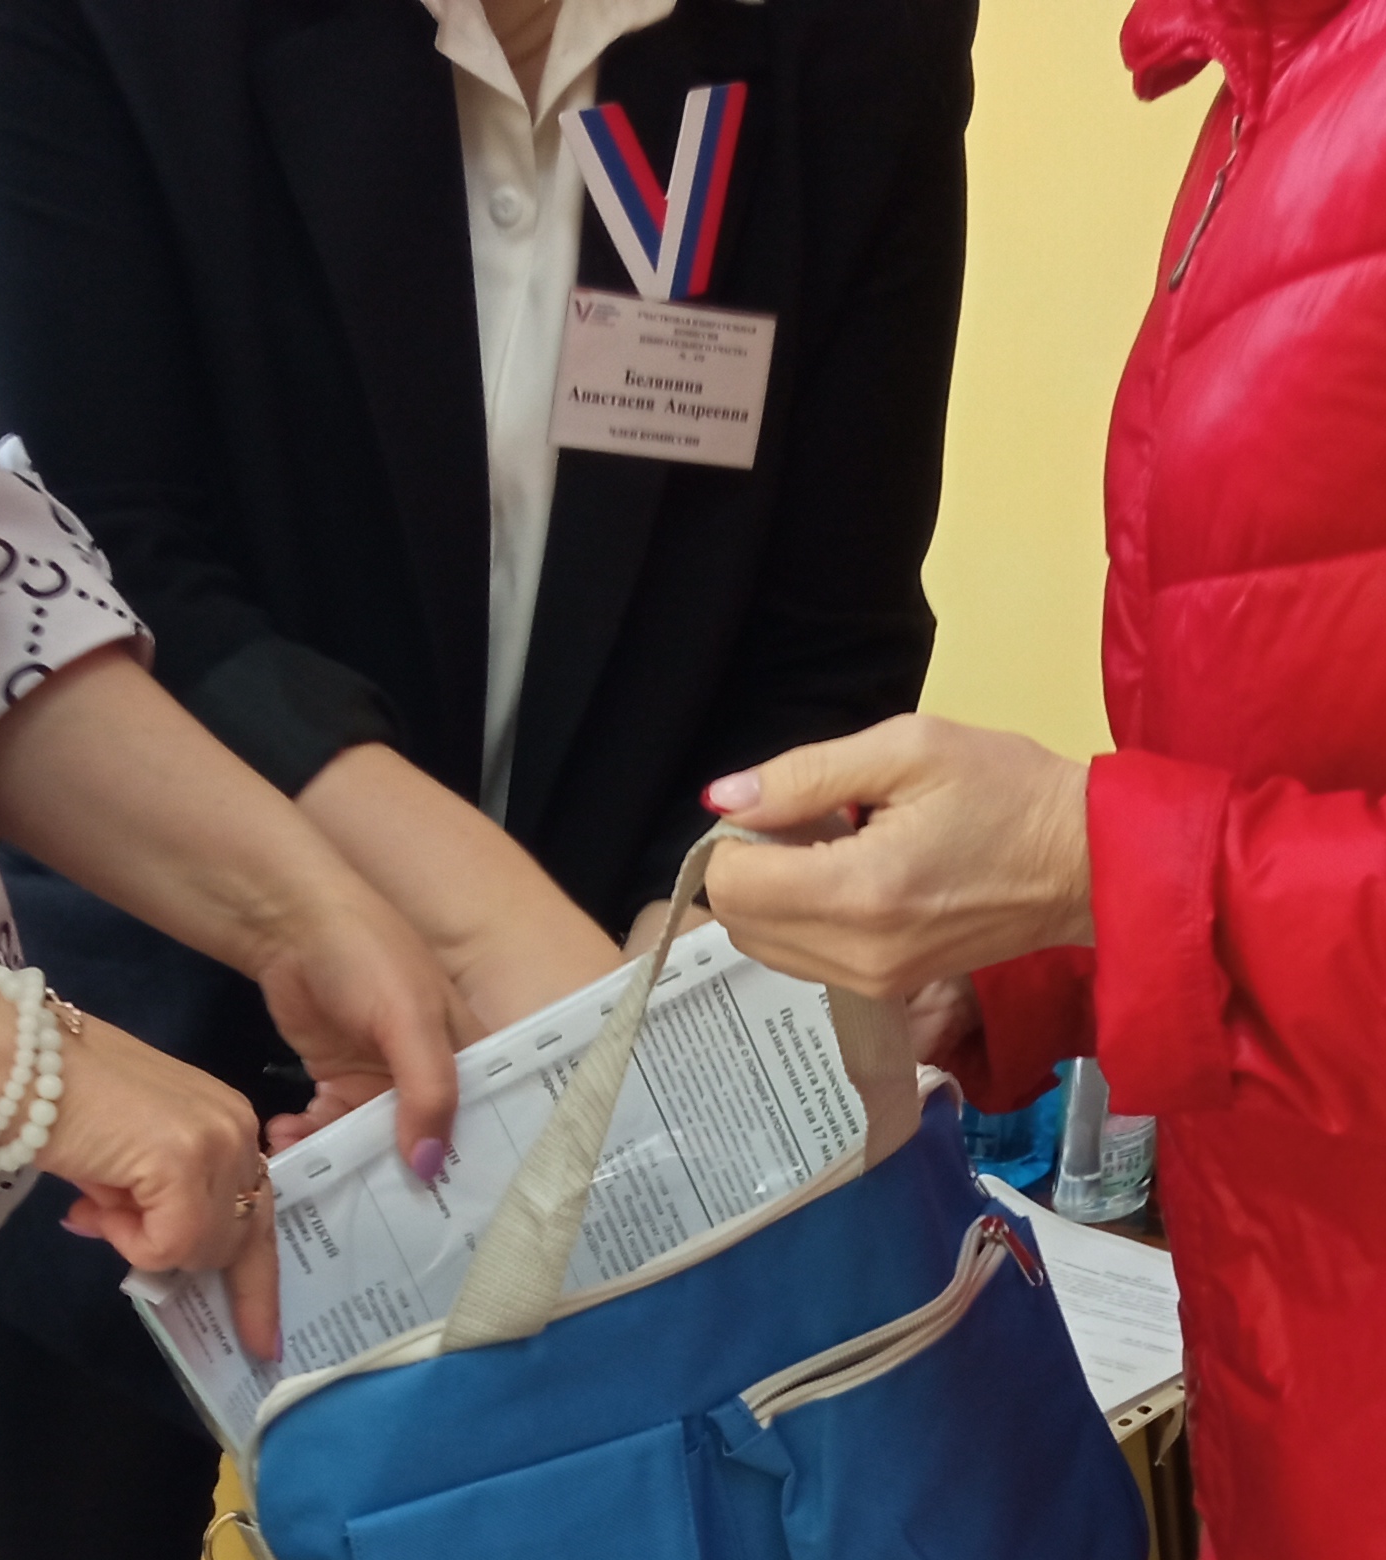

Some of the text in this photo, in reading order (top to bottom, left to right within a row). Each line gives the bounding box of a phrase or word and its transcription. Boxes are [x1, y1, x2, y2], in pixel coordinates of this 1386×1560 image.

[569, 386, 749, 425] Анастасия Андреевна
[765, 1018, 808, 1105] назначенных
[804, 1106, 816, 1124] на
[813, 1126, 828, 1140] 17
[780, 1007, 818, 1085] Президента
[818, 1053, 860, 1135] голосования
